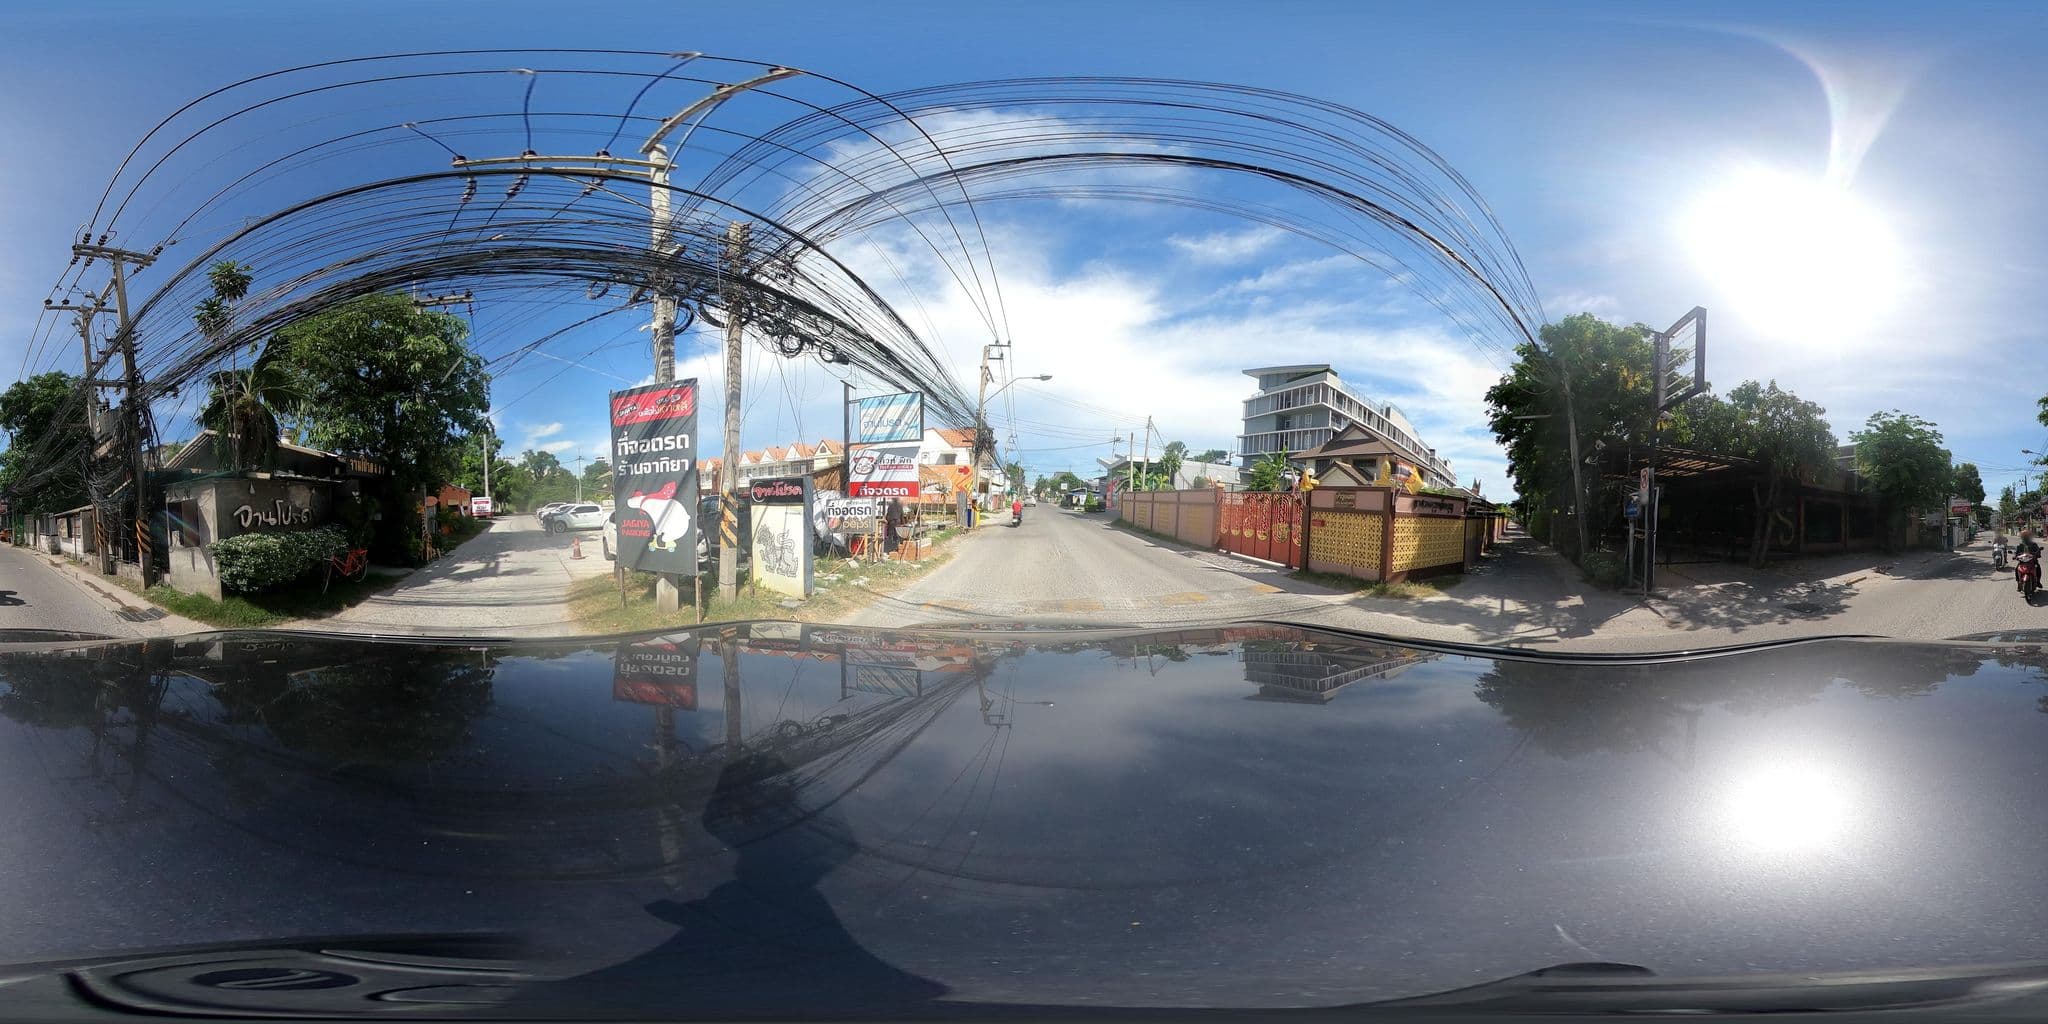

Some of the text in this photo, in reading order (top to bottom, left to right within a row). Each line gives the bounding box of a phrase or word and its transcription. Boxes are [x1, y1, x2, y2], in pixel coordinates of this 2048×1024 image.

[617, 431, 690, 456] ที่จอดรถ
[618, 456, 689, 476] ร้านจากิยา
[859, 483, 909, 496] ที่จอดรถ
[827, 502, 872, 516] ที่จอดรถ
[623, 519, 650, 528] JAGIYA
